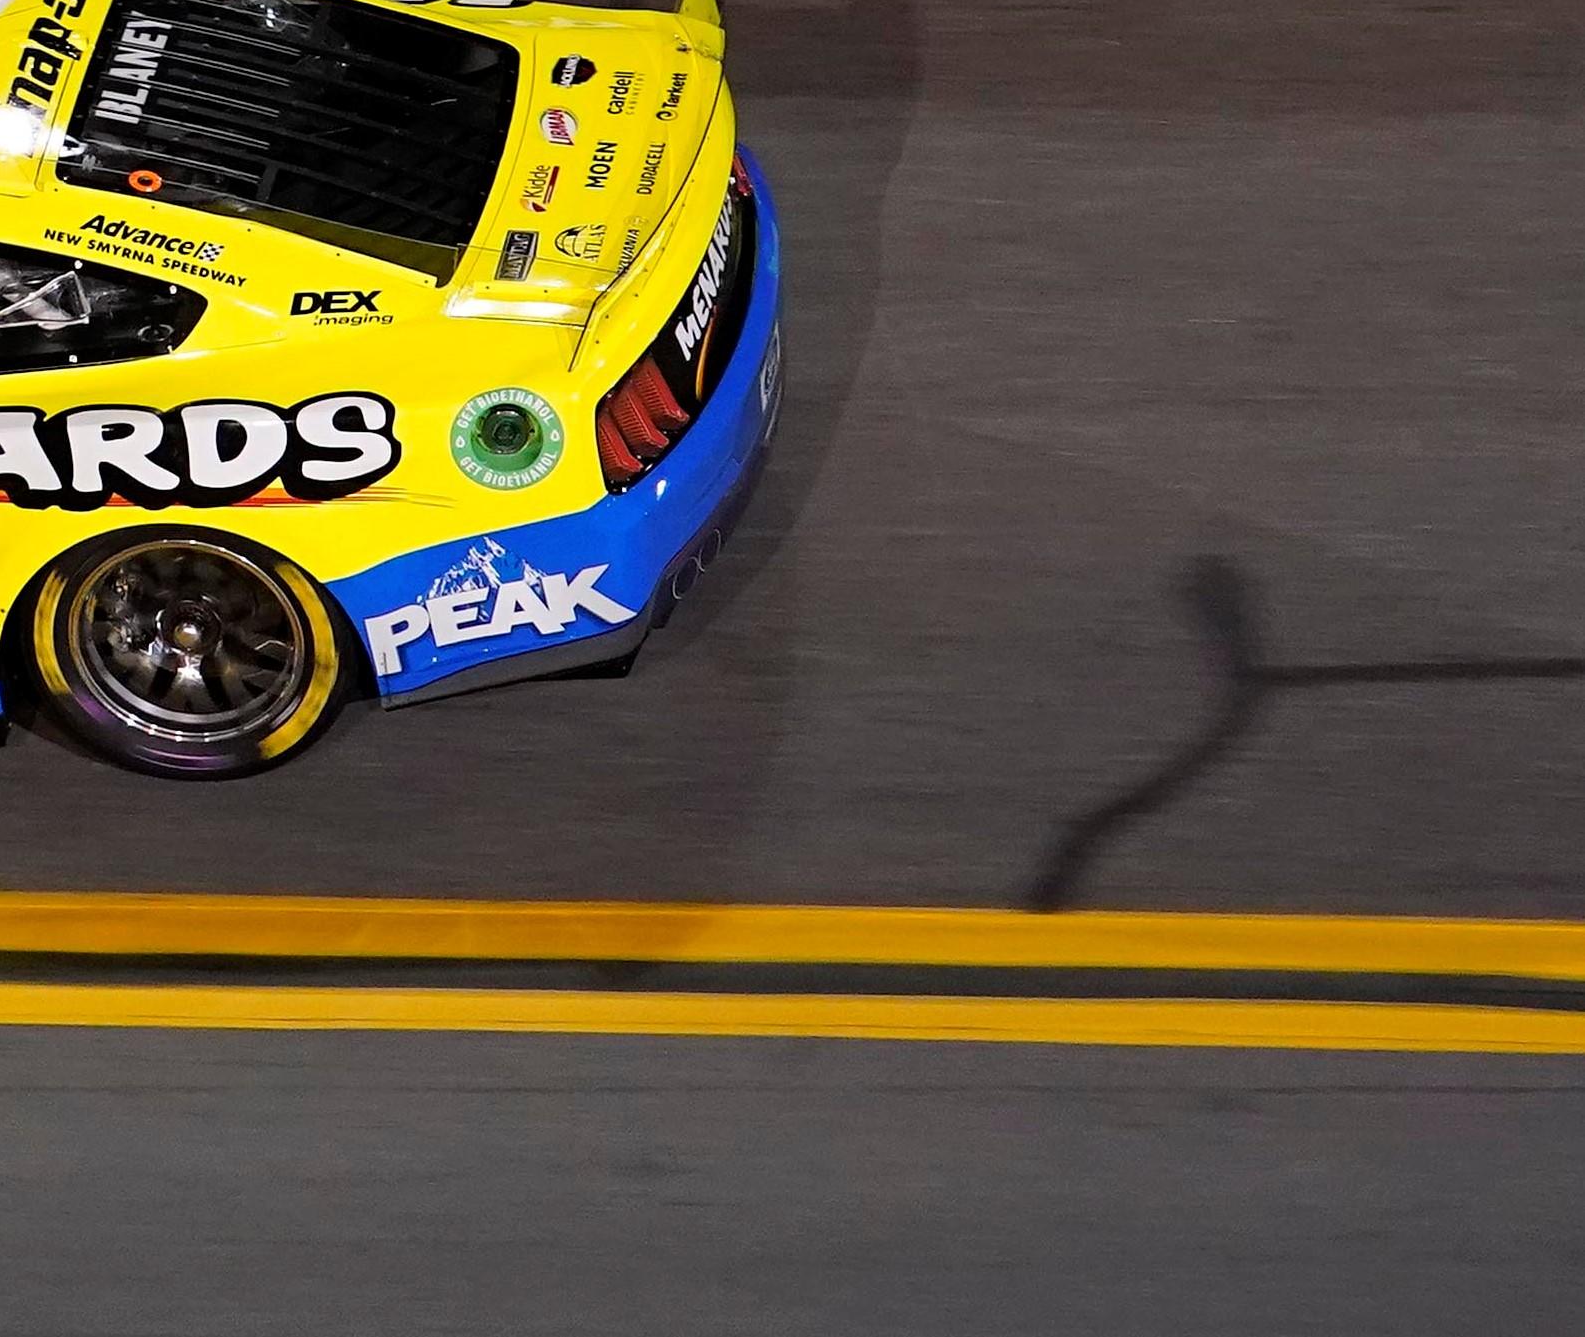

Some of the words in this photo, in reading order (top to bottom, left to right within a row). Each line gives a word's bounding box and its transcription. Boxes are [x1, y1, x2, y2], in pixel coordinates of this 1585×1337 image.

[94, 9, 173, 125] BLANEY
[607, 71, 635, 115] cardell
[661, 72, 689, 111] Tarkett
[546, 108, 575, 147] LIBMAN
[523, 164, 551, 199] Kidde
[584, 141, 619, 190] MOEN
[635, 142, 667, 196] DURACELL
[43, 227, 83, 247] NEW
[86, 239, 156, 266] SMYRNA
[161, 256, 247, 288] SPEEDWAY
[79, 214, 197, 258] Advance
[583, 223, 608, 263] ATLAS
[674, 194, 733, 362] MENAR
[289, 290, 383, 316] DEX
[456, 400, 477, 429] GET
[476, 388, 556, 427] BIOETHANOL
[482, 450, 558, 488] BIOETHANOL
[364, 563, 638, 677] PEAK
